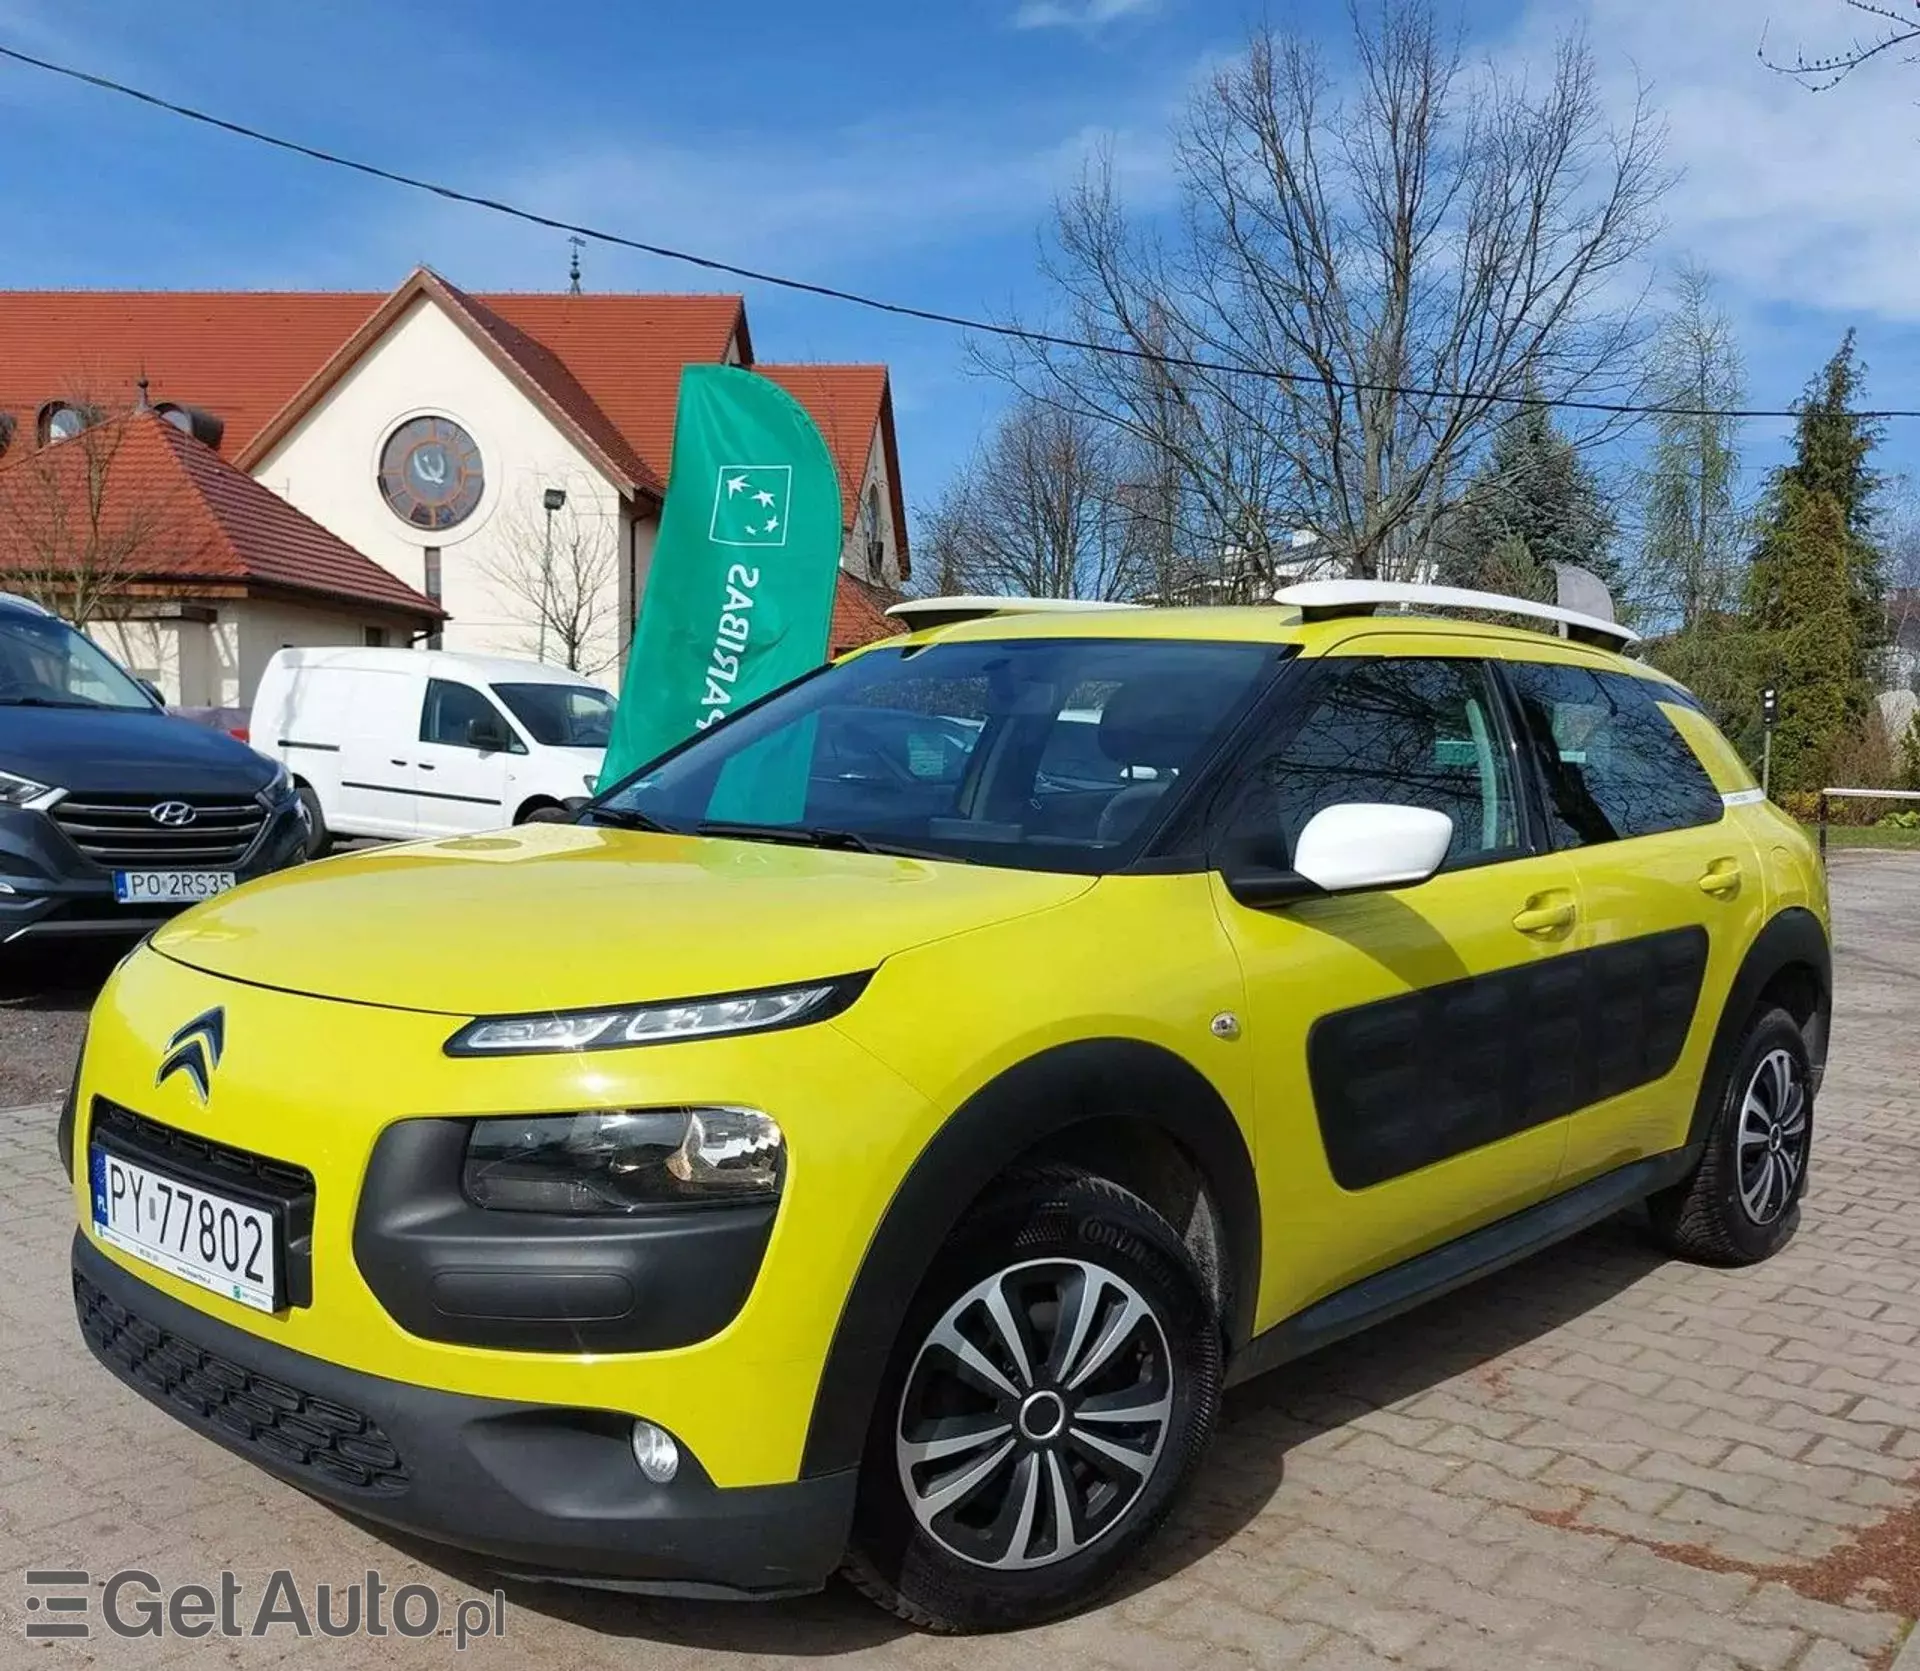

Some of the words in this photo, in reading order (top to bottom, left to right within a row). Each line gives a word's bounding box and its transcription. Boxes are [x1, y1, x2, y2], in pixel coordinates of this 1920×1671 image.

[131, 874, 160, 895] PO
[168, 874, 232, 896] 2RS35
[110, 1163, 144, 1233] PY
[157, 1182, 264, 1284] 77802
